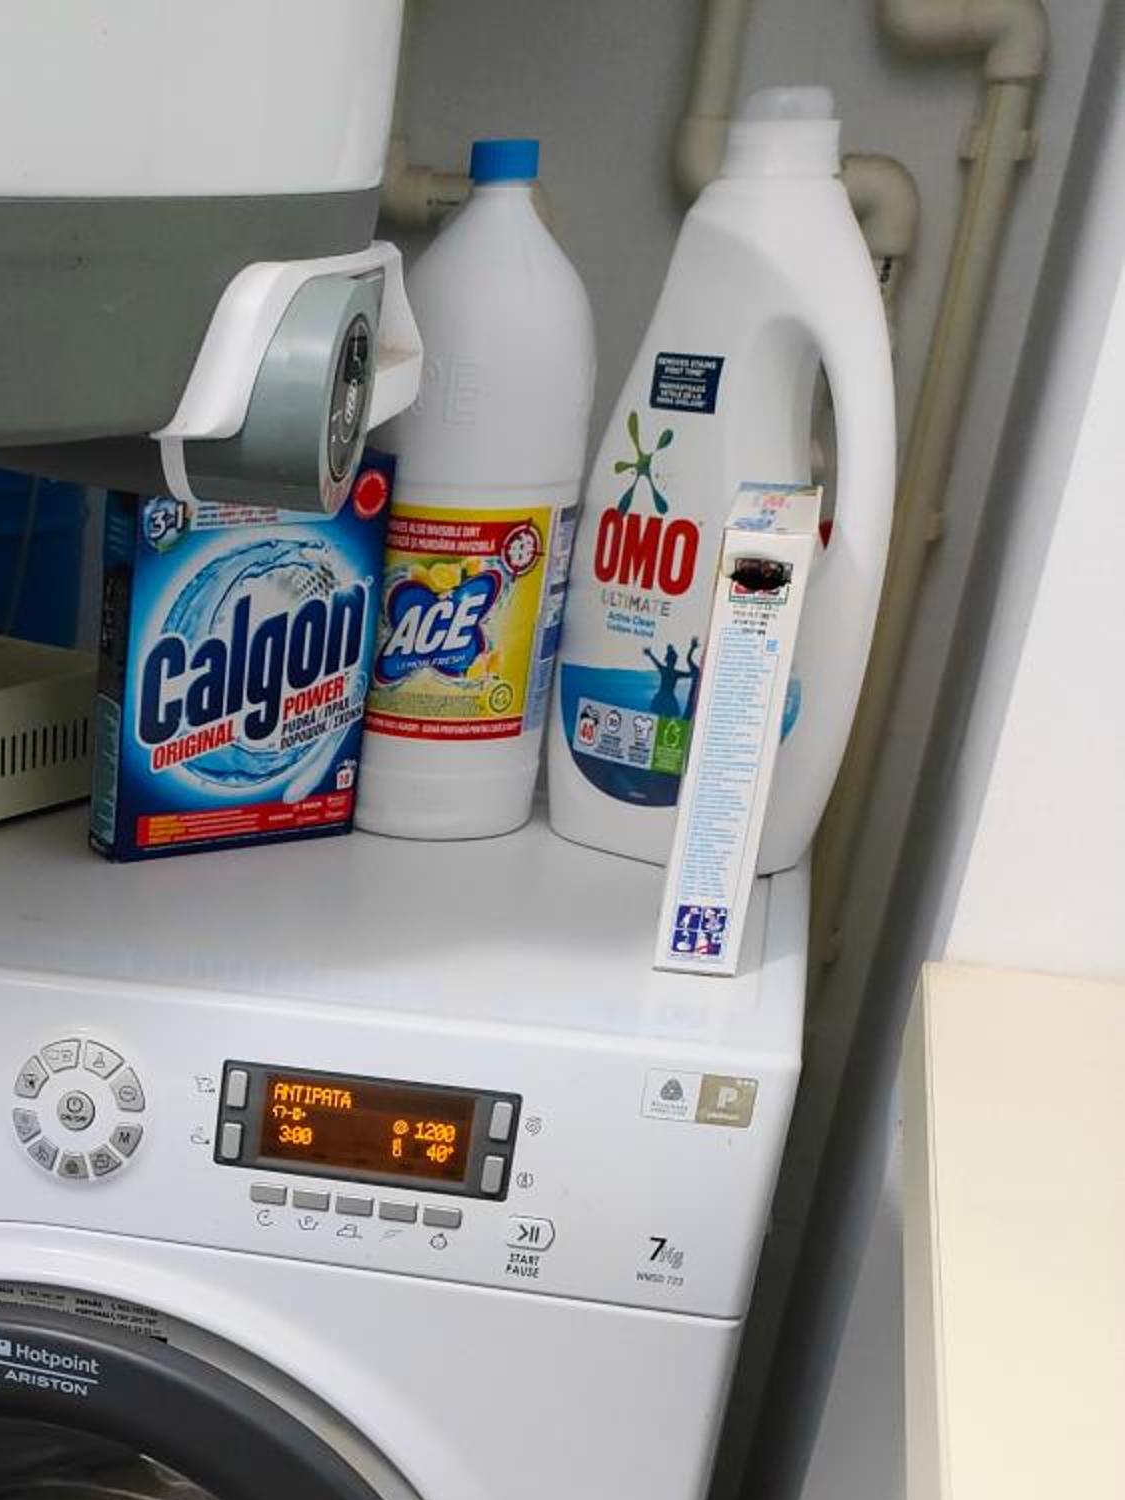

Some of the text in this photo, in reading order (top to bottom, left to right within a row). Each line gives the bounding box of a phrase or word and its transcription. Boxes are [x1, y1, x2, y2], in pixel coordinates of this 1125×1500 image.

[594, 507, 700, 596] OMO
[601, 588, 672, 617] ULTIMATE
[383, 594, 487, 657] ACE
[139, 583, 368, 745] Calgon
[432, 655, 467, 667] FRESH
[283, 675, 345, 721] POWER
[152, 722, 235, 770] ORIGINAL
[414, 1121, 455, 1143] 1200
[505, 1263, 539, 1279] PAUSE
[509, 1253, 540, 1266] START
[16, 1343, 100, 1375] Hotpoint
[4, 1369, 89, 1397] ARISTON
